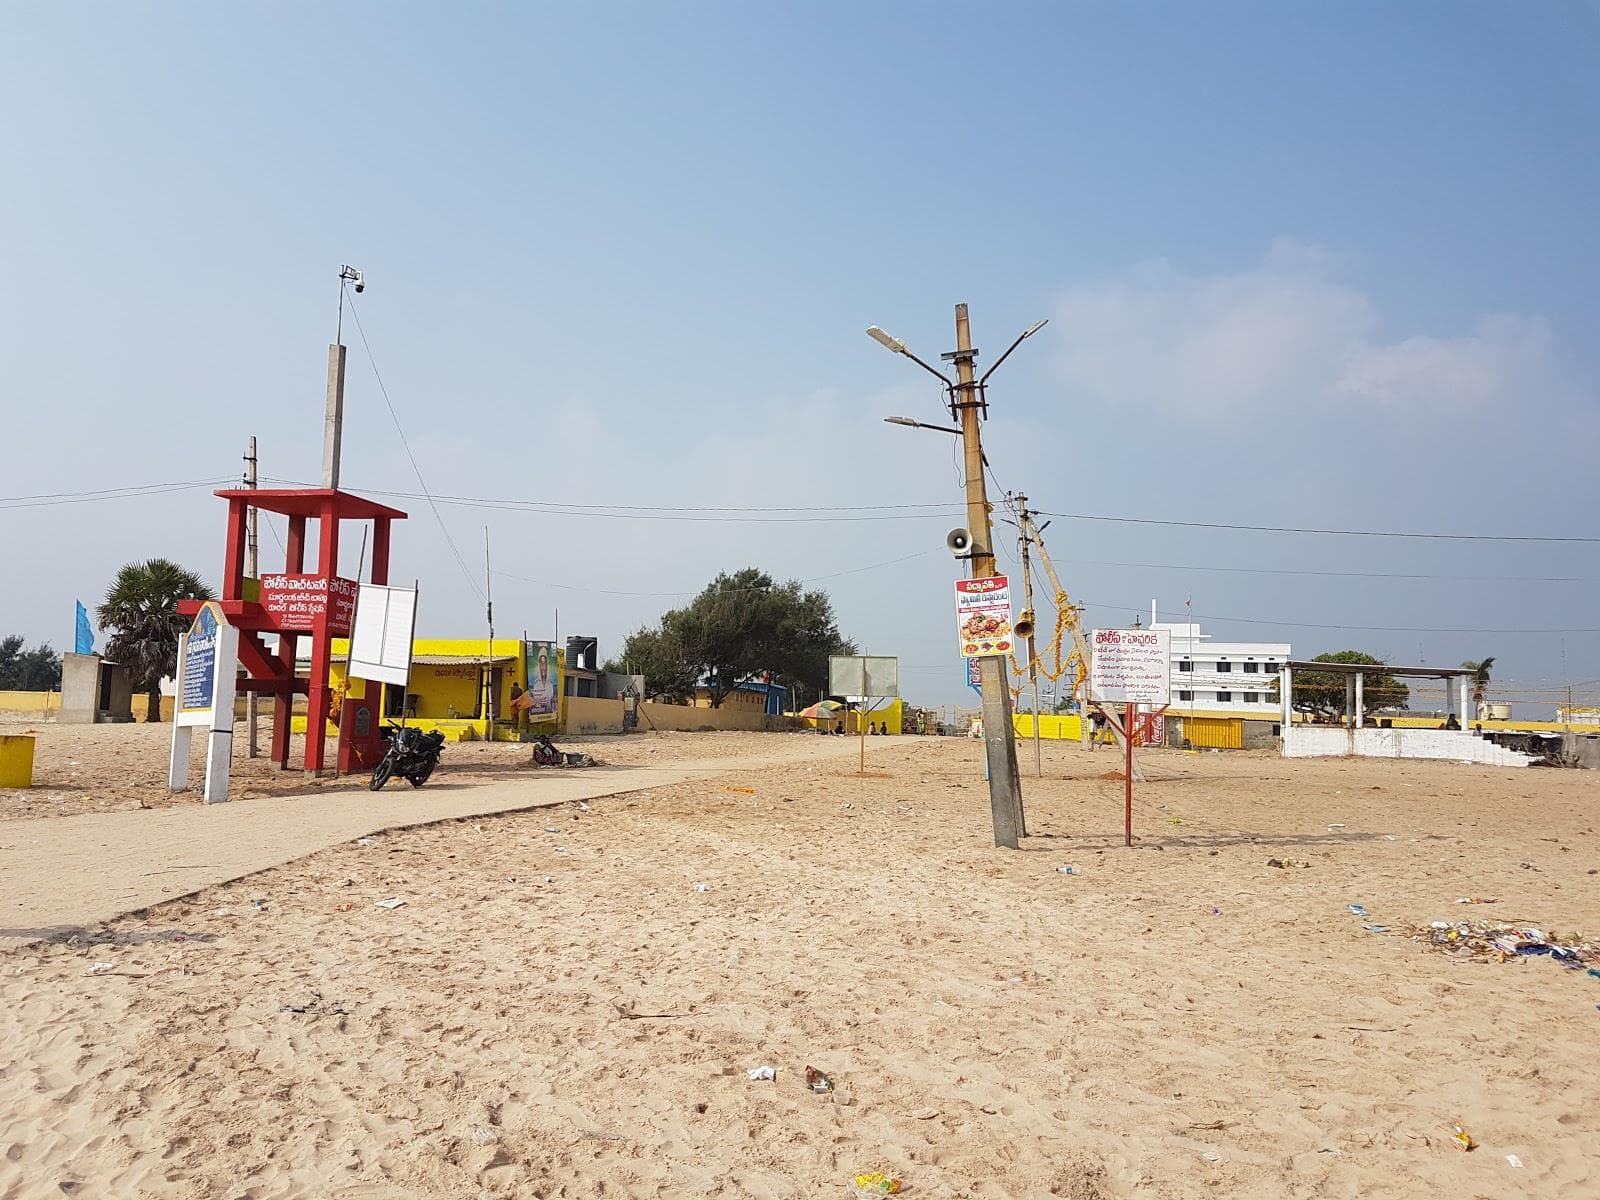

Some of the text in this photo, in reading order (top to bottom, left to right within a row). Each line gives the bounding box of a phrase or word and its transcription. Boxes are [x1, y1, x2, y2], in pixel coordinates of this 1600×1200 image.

[264, 576, 288, 589] పోలీస్
[307, 579, 327, 590] టవర్
[1096, 631, 1121, 644] పోలీస్
[1151, 715, 1162, 742] Coca-Cola
